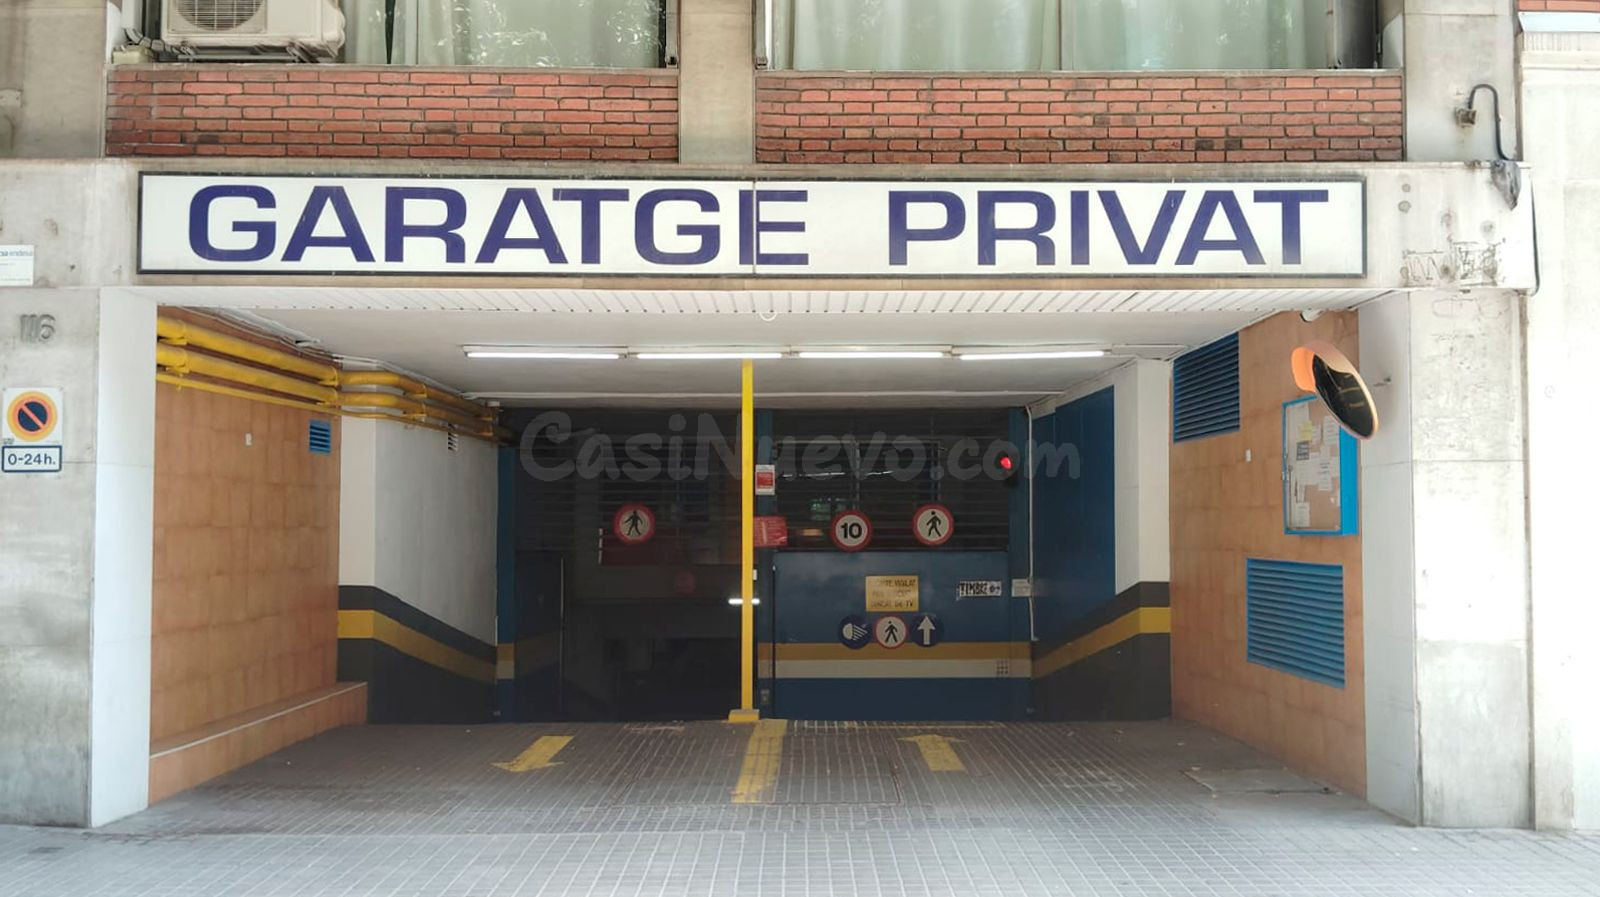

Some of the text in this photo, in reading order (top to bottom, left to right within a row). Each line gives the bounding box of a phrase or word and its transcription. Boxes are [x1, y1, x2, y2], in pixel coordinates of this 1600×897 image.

[189, 185, 808, 264] GARATGE
[888, 190, 1329, 265] PRIVAT
[841, 522, 863, 539] 10
